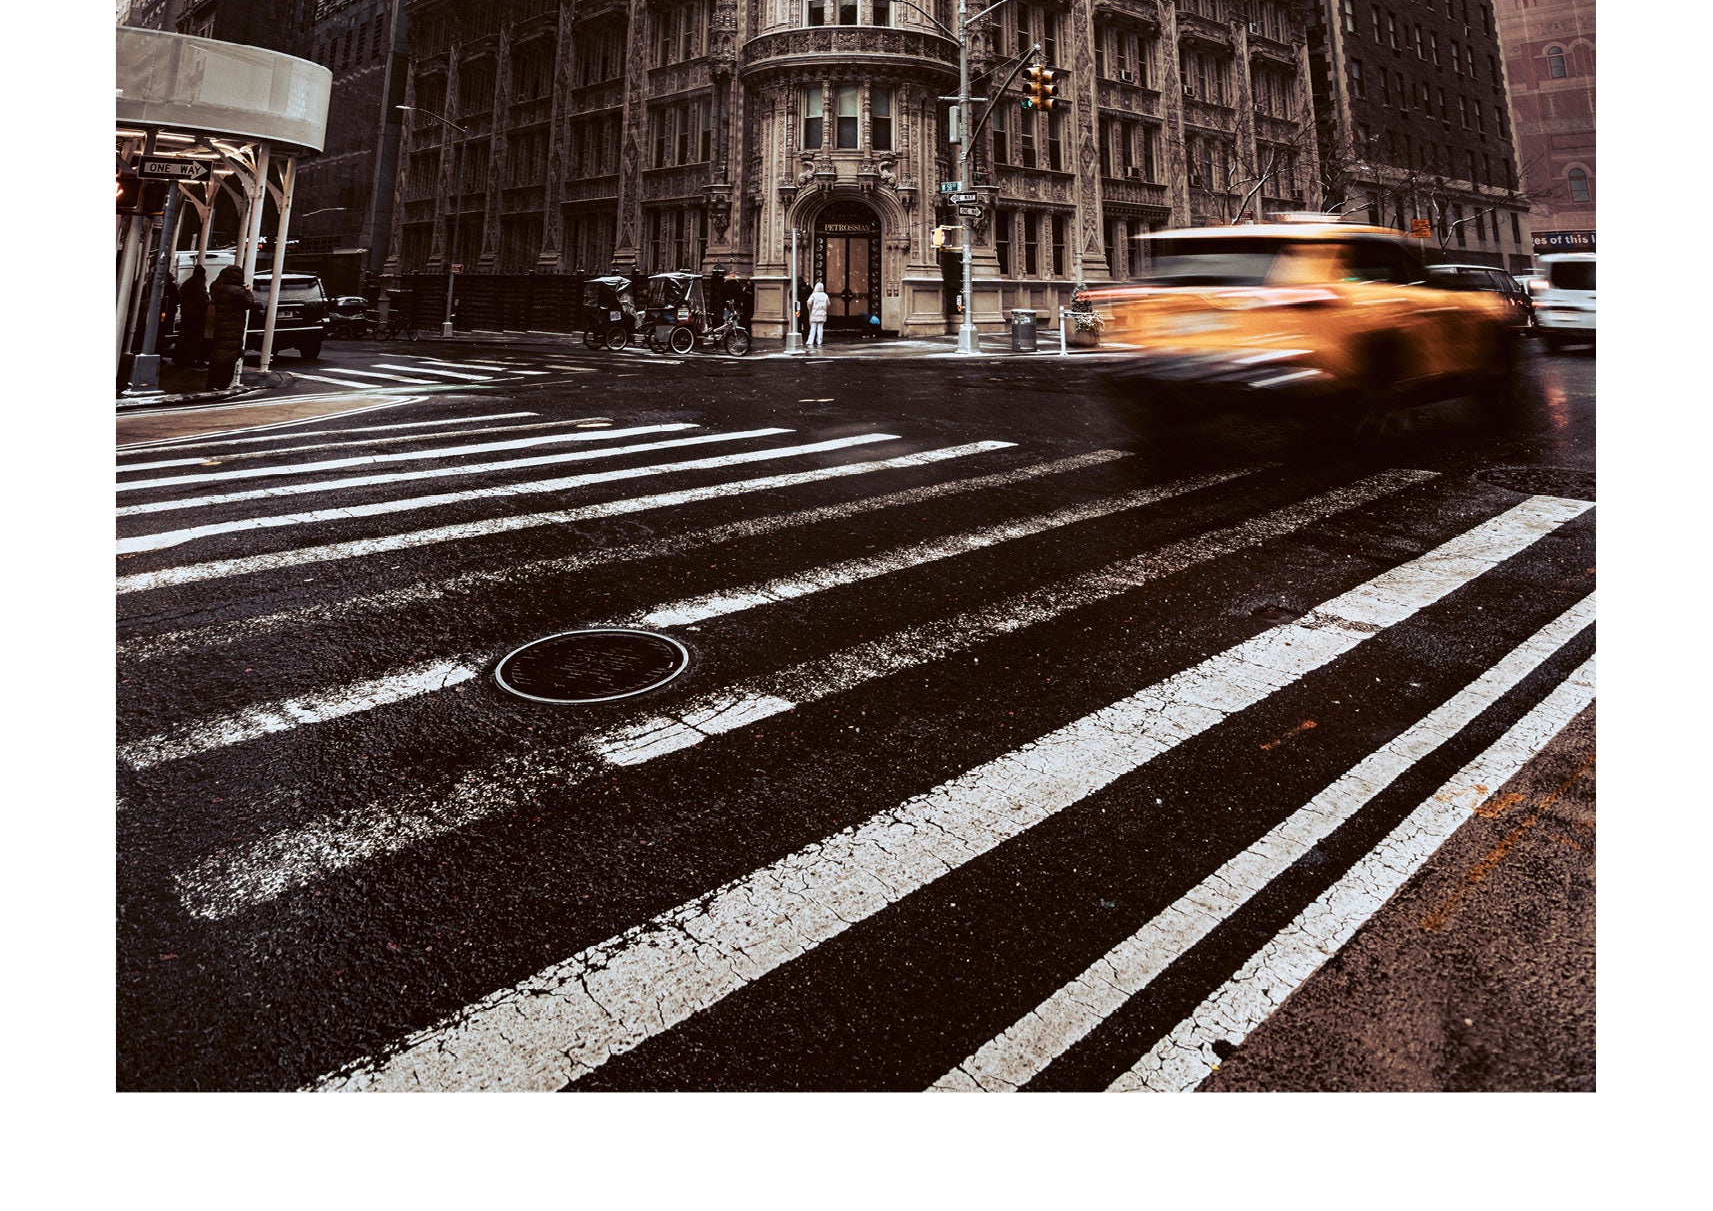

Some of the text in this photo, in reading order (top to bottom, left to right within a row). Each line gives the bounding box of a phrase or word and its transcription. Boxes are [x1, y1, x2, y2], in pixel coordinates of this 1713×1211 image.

[149, 163, 202, 175] ONE WAY
[1549, 235, 1562, 244] of
[1565, 234, 1589, 244] this
